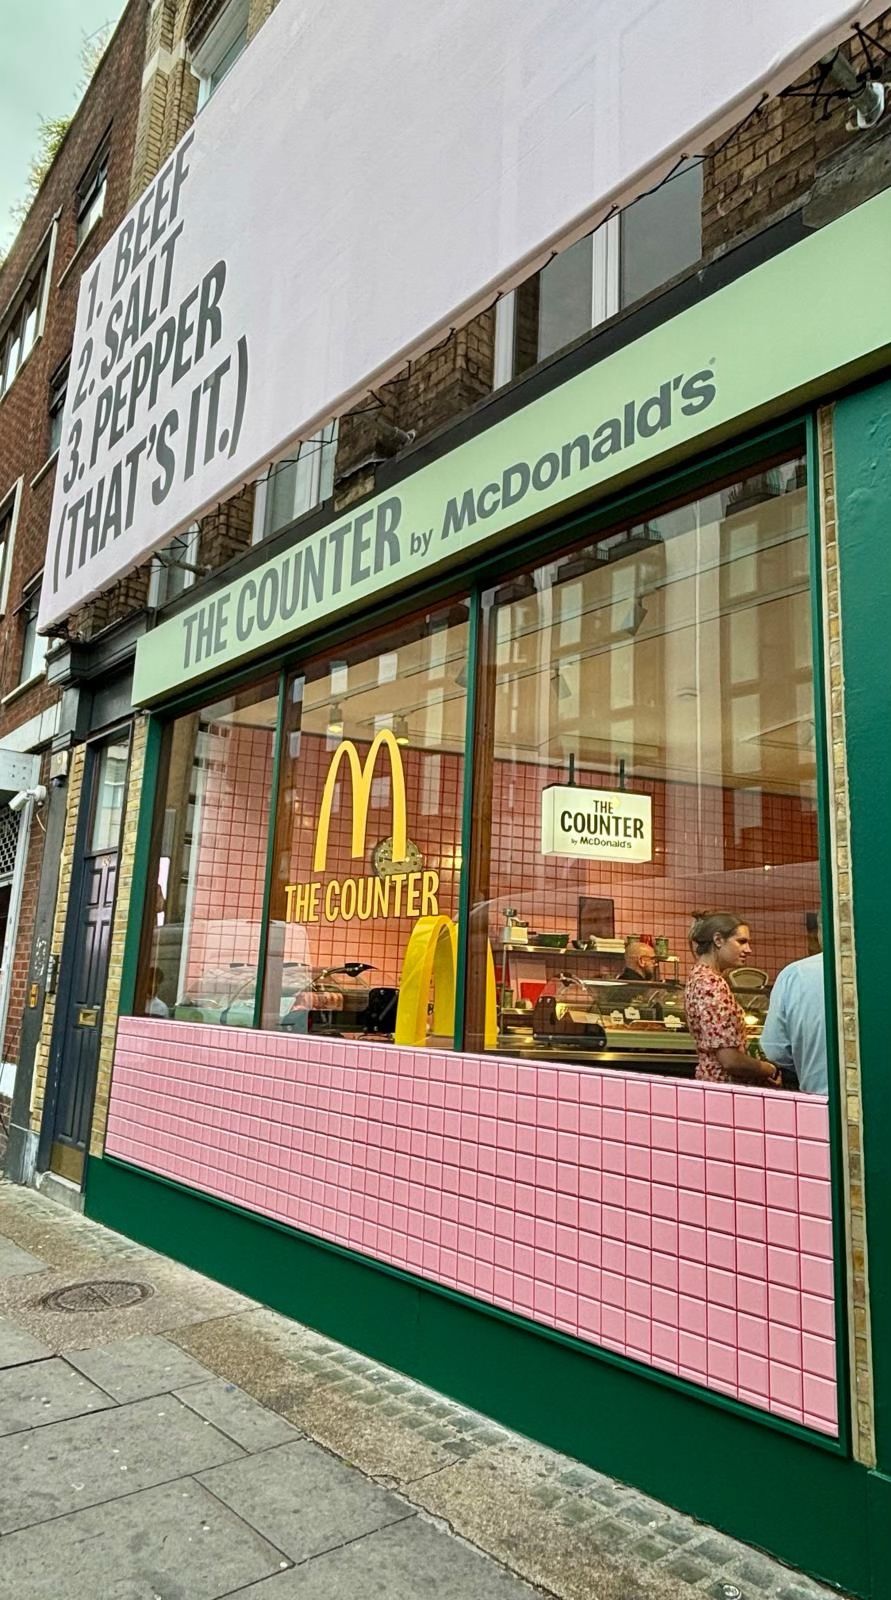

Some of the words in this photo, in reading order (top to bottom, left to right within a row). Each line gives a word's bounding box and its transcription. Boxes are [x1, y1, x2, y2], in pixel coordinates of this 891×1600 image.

[72, 342, 95, 413] 2.
[100, 220, 184, 379] SALT
[87, 262, 104, 331] 1.
[111, 131, 195, 296] BEEF
[53, 409, 179, 593] (THAT'S
[184, 335, 249, 482] IT.)
[63, 418, 85, 494] 3.
[89, 260, 227, 469] PEPPER
[183, 600, 230, 669] THE
[236, 496, 402, 642] COUNTER
[409, 528, 433, 556] by
[440, 368, 717, 540] McDonald's
[285, 883, 321, 922] THE
[325, 871, 440, 921] COUNTER
[560, 810, 645, 839] COUNTER
[580, 837, 632, 849] McDonald's
[593, 800, 614, 814] THE
